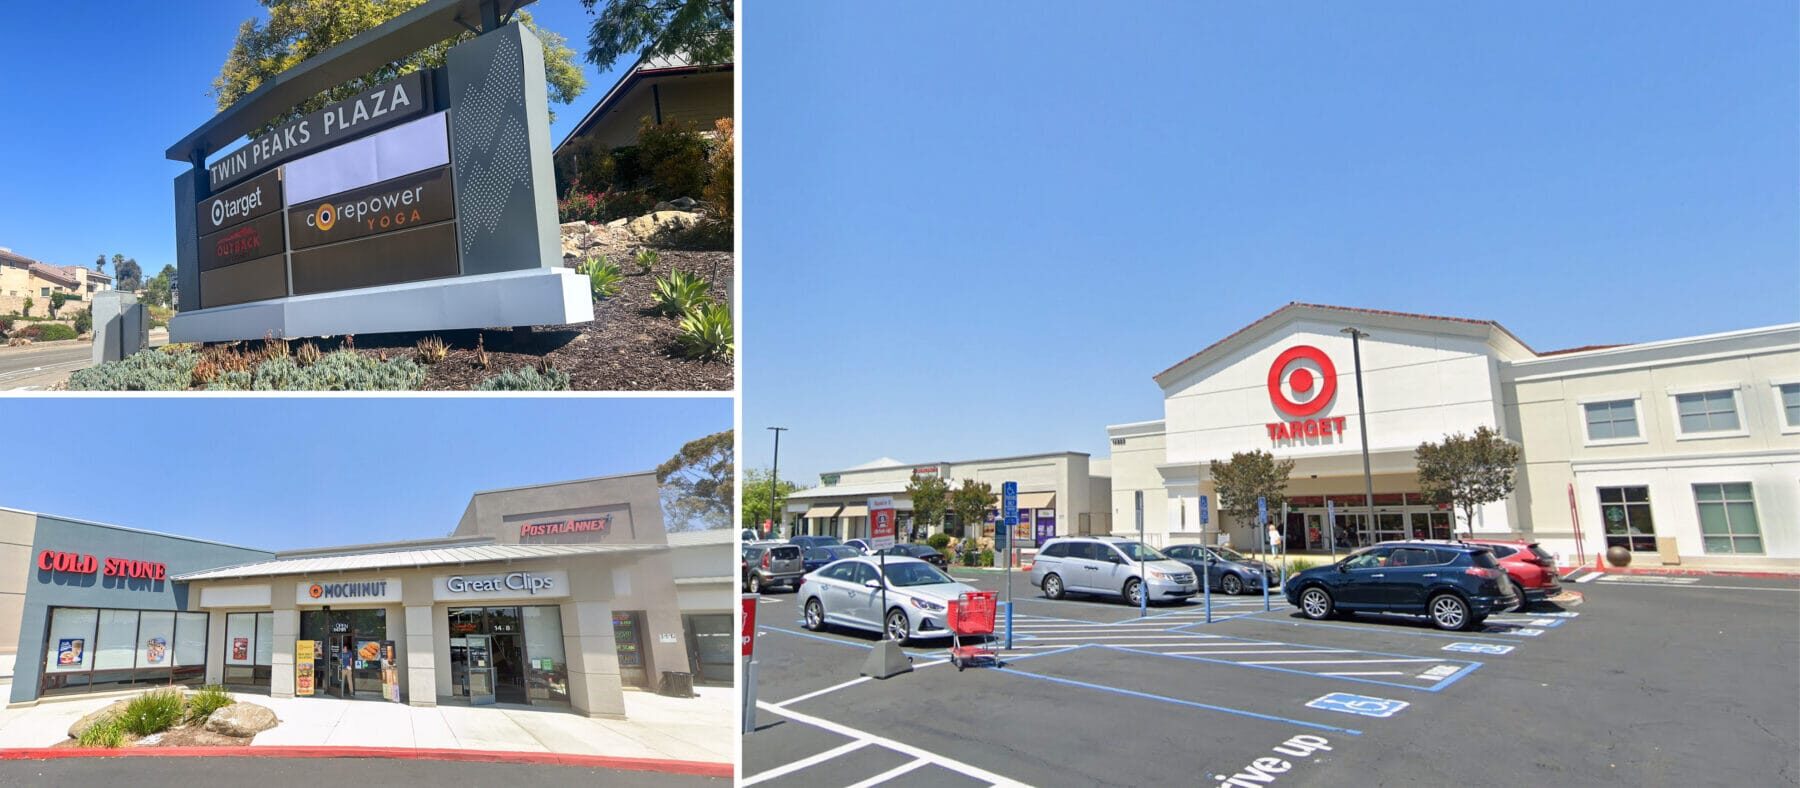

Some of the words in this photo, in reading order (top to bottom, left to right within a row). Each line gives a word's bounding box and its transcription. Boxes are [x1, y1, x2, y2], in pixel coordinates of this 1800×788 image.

[210, 150, 247, 184] TWIN
[253, 121, 310, 165] PEAKS
[323, 84, 410, 135] PLAZA
[225, 186, 262, 217] target
[306, 187, 423, 231] corepower
[367, 209, 421, 231] YOGA
[216, 236, 262, 256] OUTBACK
[1265, 416, 1347, 441] TARGET
[38, 549, 98, 574] COLD
[103, 556, 167, 580] STONE
[324, 581, 387, 598] MOCHINUT
[447, 576, 503, 593] Great
[505, 572, 555, 595] Clips
[1272, 734, 1333, 757] up
